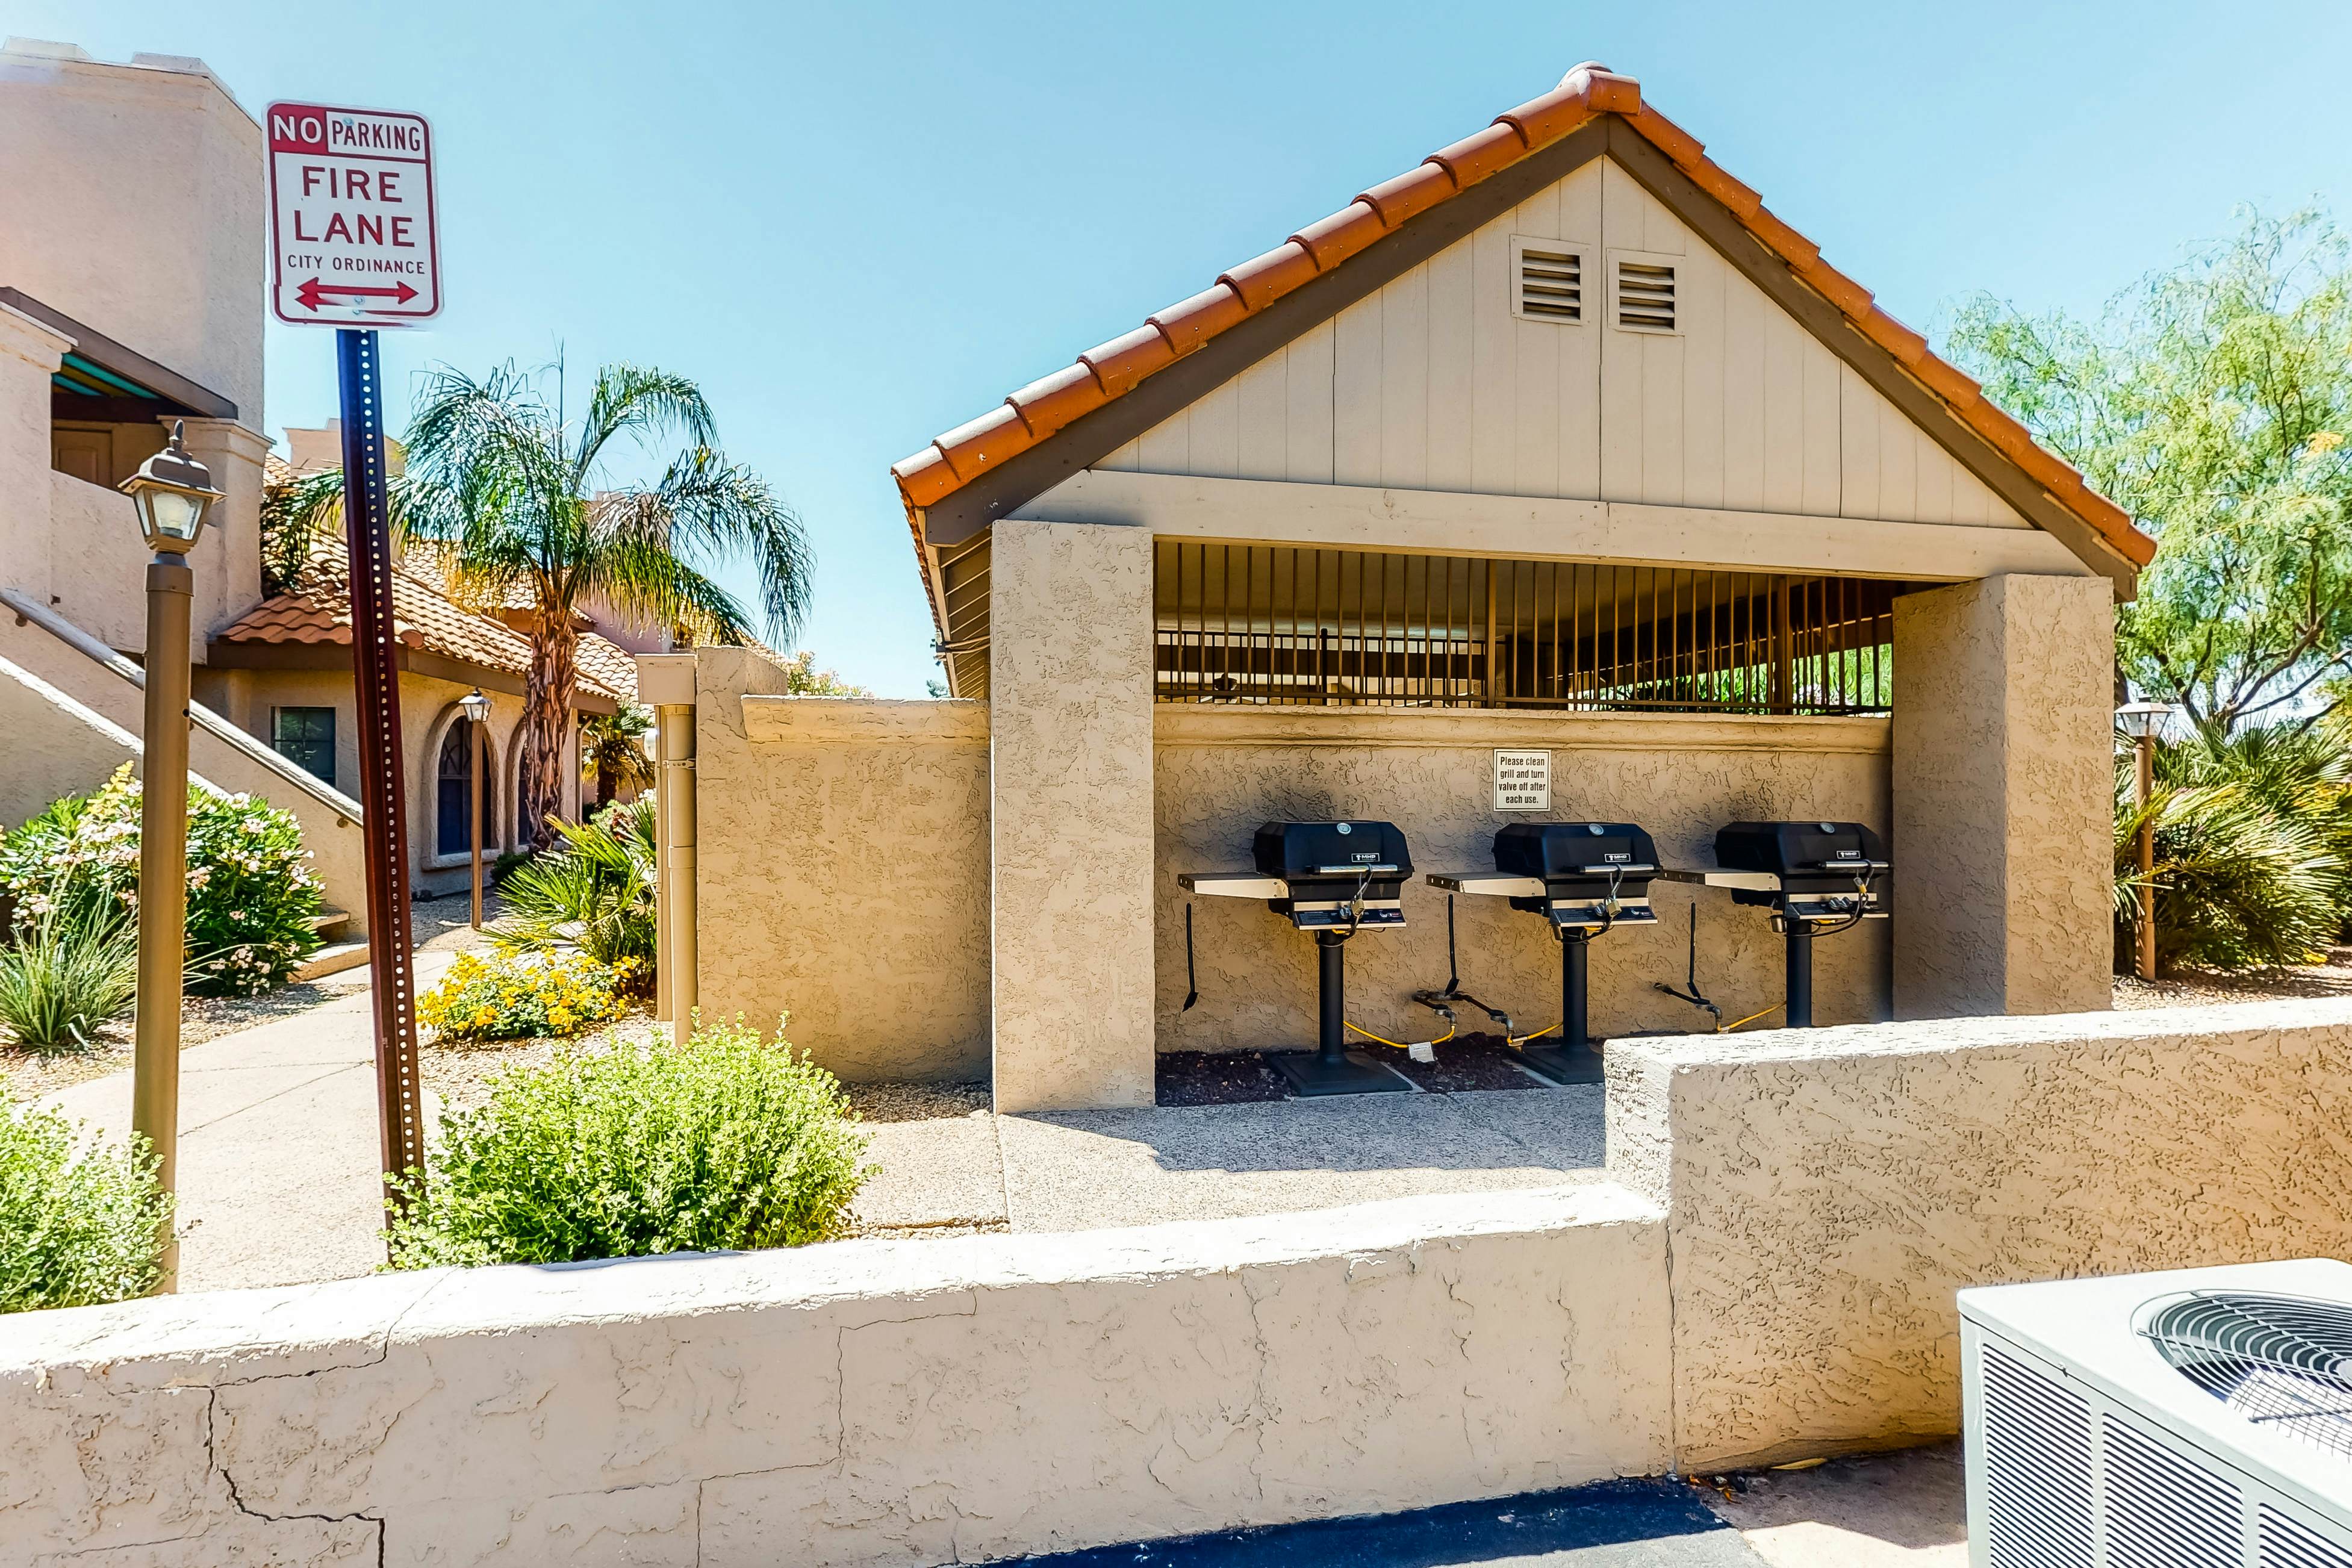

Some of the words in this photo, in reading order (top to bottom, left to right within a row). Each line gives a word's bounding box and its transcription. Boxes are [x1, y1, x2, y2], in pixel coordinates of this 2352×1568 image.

[274, 114, 322, 144] NO
[332, 120, 420, 151] PARKING
[302, 165, 402, 203] FIRE
[294, 210, 415, 247] LANE
[287, 255, 323, 270] CITY
[332, 257, 425, 275] ORDINANCE
[1500, 756, 1523, 766] Please
[1526, 757, 1545, 766] clean
[1500, 769, 1514, 779] grill
[1516, 769, 1529, 779] and
[1531, 770, 1545, 779] turn
[1498, 782, 1517, 791] valve
[1519, 782, 1528, 791] off
[1530, 782, 1546, 791] after
[1505, 795, 1522, 804] each
[1525, 795, 1538, 804] use.
